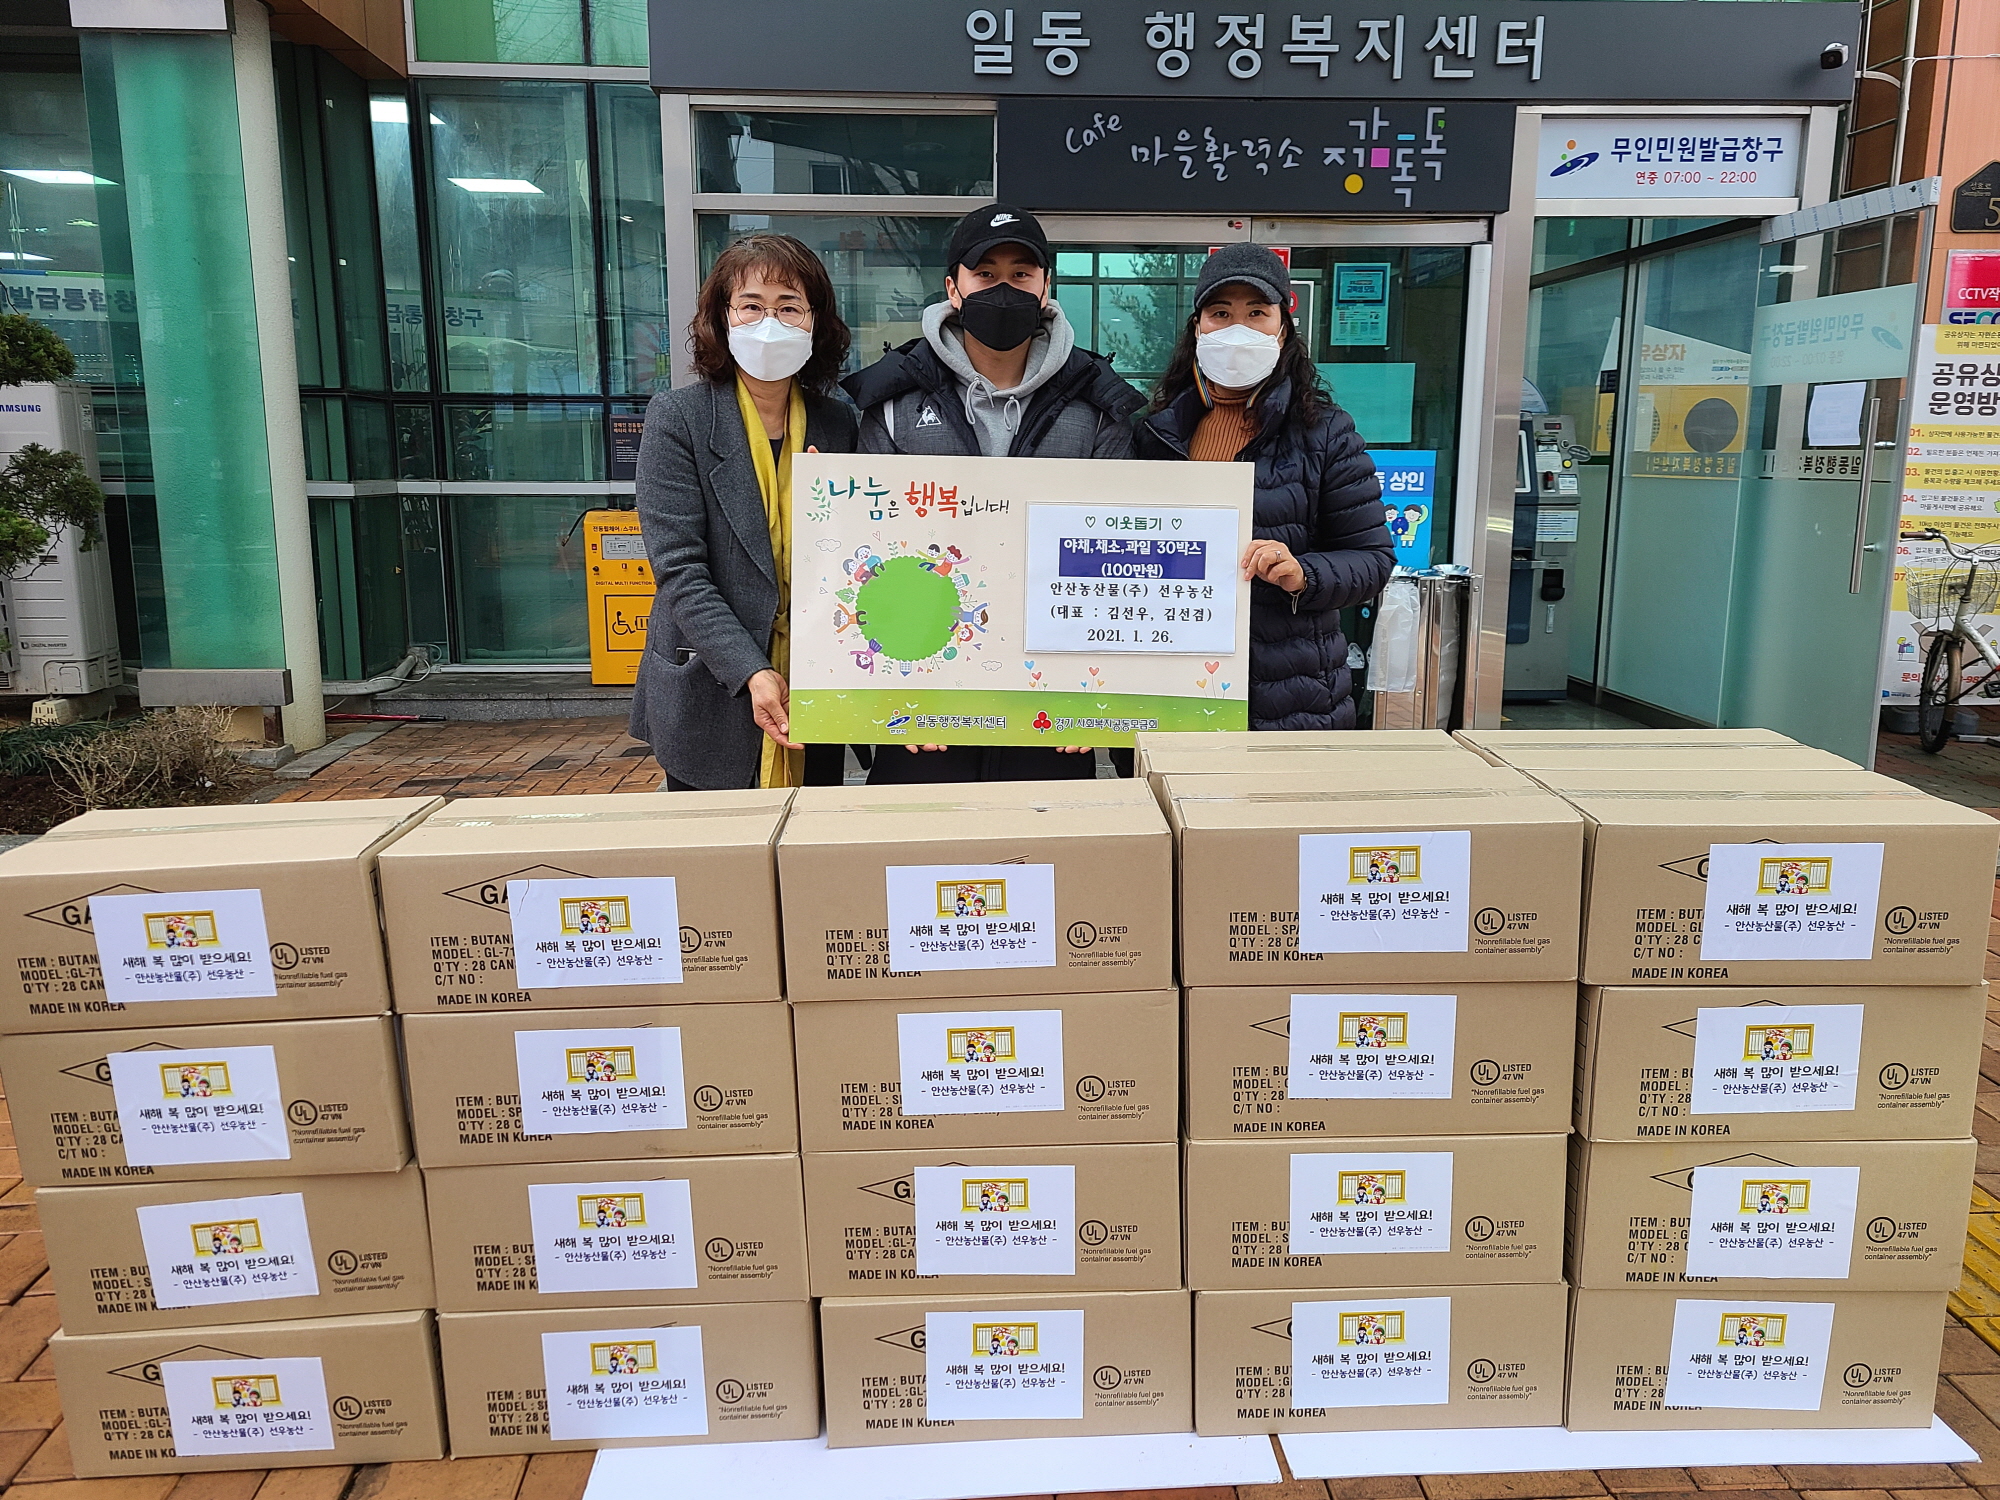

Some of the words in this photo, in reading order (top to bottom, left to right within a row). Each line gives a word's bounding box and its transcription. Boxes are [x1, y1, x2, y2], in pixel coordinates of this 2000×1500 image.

[966, 9, 1091, 78] 일동
[1144, 9, 1546, 82] 행정복지센터
[1065, 112, 1122, 154] Cafe
[1131, 126, 1303, 181] 마을활력소
[1611, 137, 1783, 163] 무인민원발급창구
[1636, 172, 1658, 185] 연중
[1664, 172, 1700, 184] 07:00
[1720, 171, 1757, 184] 22:00
[994, 213, 1013, 222] NIKE
[1389, 470, 1424, 492] 상인
[828, 475, 900, 521] 나눔은
[904, 480, 1009, 519] 행복입니다!
[1106, 516, 1162, 531] 이웃돕기
[1064, 539, 1150, 555] 야채,채소,과일
[1157, 541, 1202, 555] 30박스
[1101, 563, 1163, 578] (100만원)
[1051, 582, 1149, 597] 안산농산물(주)
[1159, 584, 1214, 599] 선우농산
[1051, 605, 1084, 619] (대표
[1108, 607, 1154, 621] 김선우,
[1164, 608, 1212, 622] 김선겸)
[1087, 629, 1125, 642] 2021.
[1134, 630, 1143, 642] 1.
[1152, 631, 1173, 643] 26.
[916, 715, 1007, 729] 일동행정복지센터
[1055, 718, 1073, 732] 경기
[1076, 719, 1158, 733] 사회복지공동모금회
[1331, 908, 1396, 921] 안산농산물(주)
[1402, 908, 1439, 920] 선우농산
[1508, 912, 1537, 921] LISTED
[1726, 903, 1751, 916] 새해
[1757, 903, 1769, 916] 복
[1775, 903, 1800, 916] 많이
[1805, 903, 1857, 916] 받으세요!
[910, 924, 933, 937] 새해
[939, 924, 950, 937] 복
[956, 923, 980, 936] 많이
[986, 922, 1036, 934] 받으세요!
[1523, 937, 1537, 945] fuel
[1538, 939, 1550, 947] gas
[122, 956, 146, 968] 새해
[153, 955, 165, 967] 복
[170, 954, 194, 966] 많이
[200, 952, 252, 964] 받으세요!
[547, 956, 611, 969] 안산농산물(주)
[617, 955, 653, 966] 선우농산
[437, 994, 472, 1006] MADE
[475, 993, 488, 1004] IN
[491, 992, 532, 1003] KOREA
[1310, 1054, 1333, 1065] 새해
[1339, 1054, 1350, 1065] 복
[1356, 1054, 1379, 1065] 많이
[1384, 1054, 1434, 1065] 받으세요!
[542, 1090, 564, 1102] 새해
[571, 1089, 582, 1100] 복
[588, 1088, 611, 1100] 많이
[616, 1086, 665, 1098] 받으세요!
[932, 1085, 994, 1097] 안산농산물(주)
[1000, 1083, 1035, 1094] 선우농산
[1723, 1082, 1787, 1095] 안산농산물(주)
[1792, 1082, 1828, 1093] 선우농산
[151, 1121, 215, 1134] 안산농산물(주)
[221, 1120, 256, 1132] 선우농산
[1234, 1122, 1266, 1133] MADE
[1270, 1121, 1283, 1132] IN
[1286, 1121, 1326, 1132] KOREA
[936, 1220, 958, 1231] 새해
[964, 1220, 974, 1231] 복
[980, 1220, 1003, 1231] 많이
[1008, 1219, 1056, 1231] 받으세요!
[1320, 1226, 1382, 1237] 안산농산물(주)
[1387, 1225, 1423, 1236] 선우농산
[1710, 1222, 1734, 1234] 새해
[1740, 1222, 1751, 1233] 복
[1757, 1222, 1779, 1234] 많이
[1786, 1222, 1835, 1233] 받으세요!
[565, 1251, 627, 1263] 안산농산물(주)
[632, 1250, 667, 1260] 선우농산
[171, 1263, 194, 1275] 새해
[200, 1262, 211, 1273] 복
[216, 1260, 239, 1273] 많이
[244, 1256, 295, 1271] 받으세요!
[1312, 1354, 1334, 1366] 새해
[1340, 1353, 1350, 1365] 복
[1356, 1353, 1378, 1364] 많이
[1383, 1351, 1432, 1363] 받으세요!
[1697, 1368, 1758, 1381] 안산농산물(주)
[1763, 1369, 1797, 1380] 선우농산
[567, 1383, 589, 1395] 새해
[595, 1383, 605, 1394] 복
[611, 1381, 634, 1393] 많이
[638, 1379, 687, 1392] 받으세요!
[956, 1378, 1017, 1390] 안산농산물(주)
[1021, 1378, 1056, 1388] 선우농산
[203, 1427, 265, 1439] 안산농산물(주)
[270, 1425, 304, 1437] 선우농산
